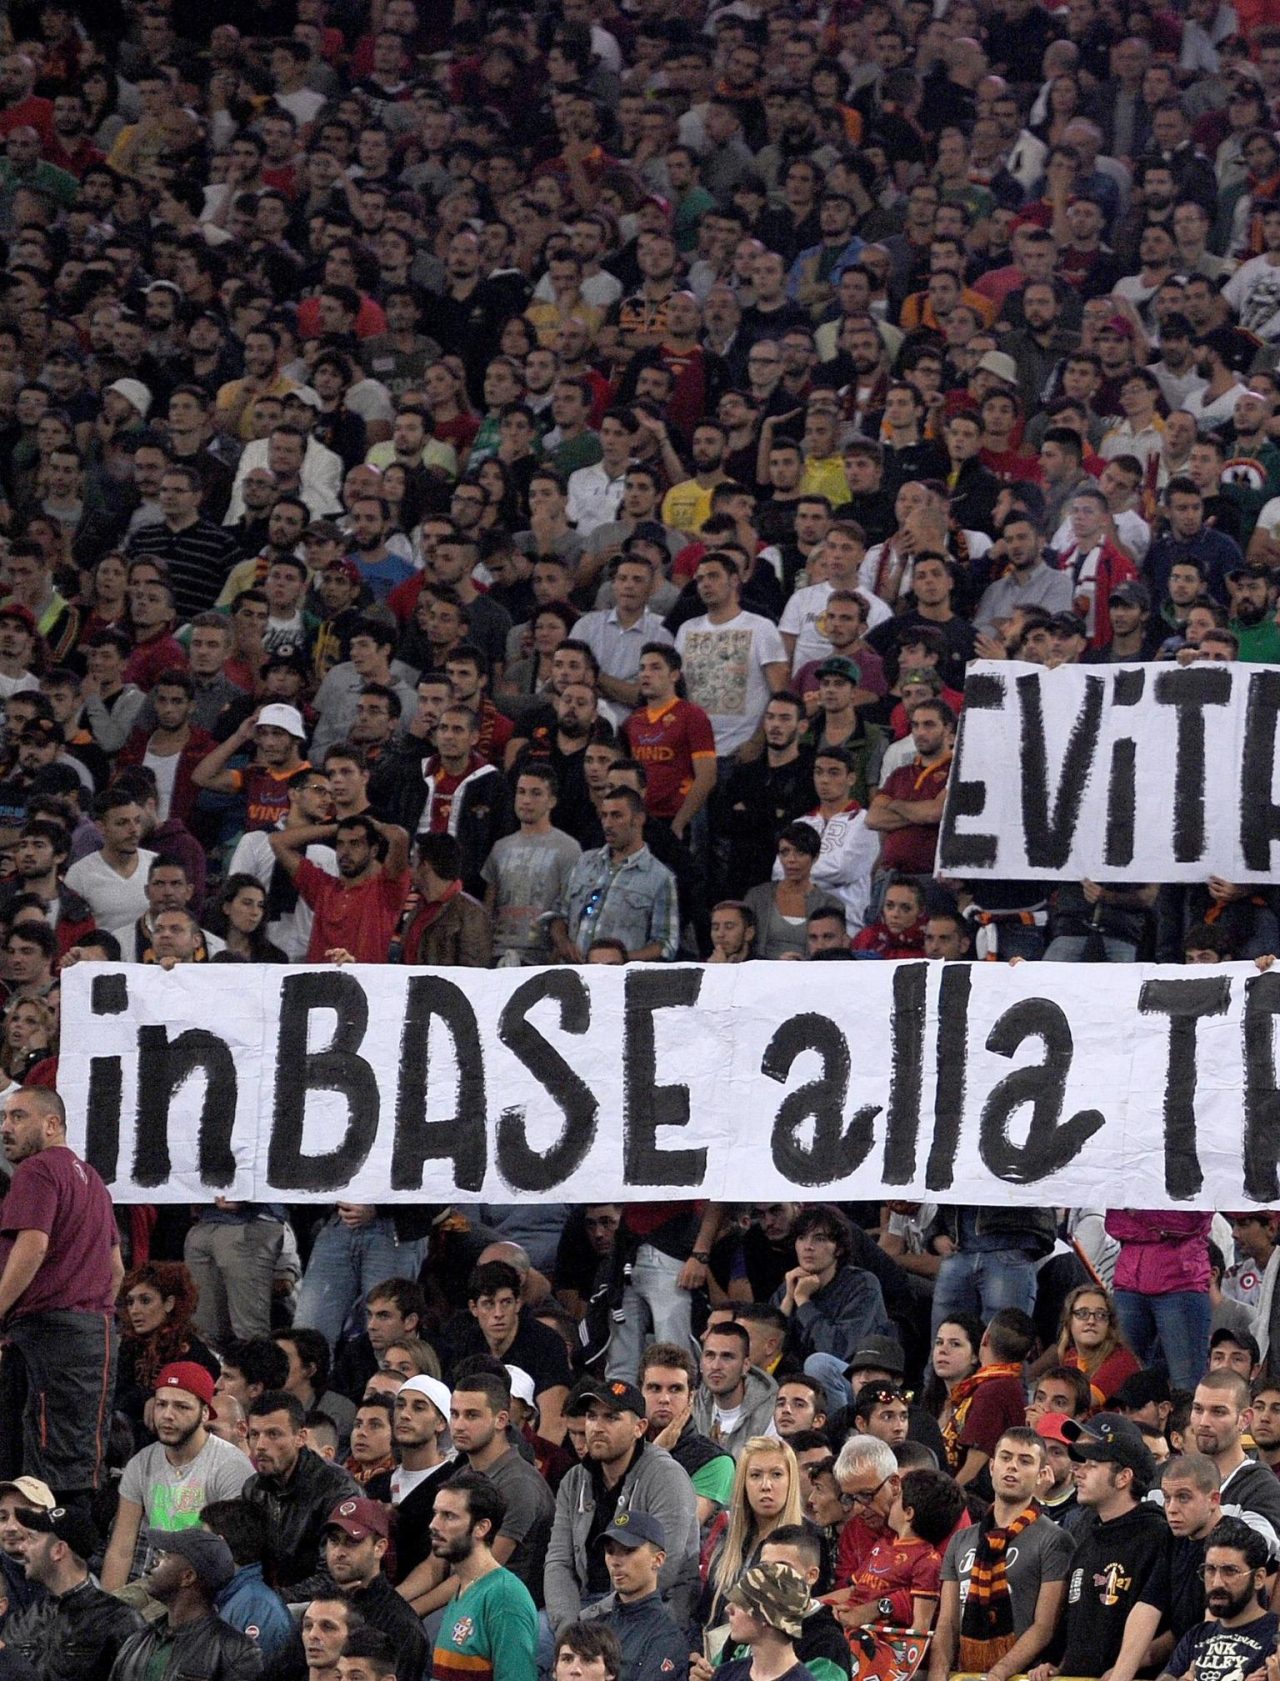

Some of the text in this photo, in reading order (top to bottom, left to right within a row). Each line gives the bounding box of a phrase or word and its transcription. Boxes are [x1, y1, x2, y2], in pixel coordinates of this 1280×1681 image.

[85, 972, 239, 1189] in
[266, 967, 708, 1192] BASE
[761, 961, 1107, 1192] alla
